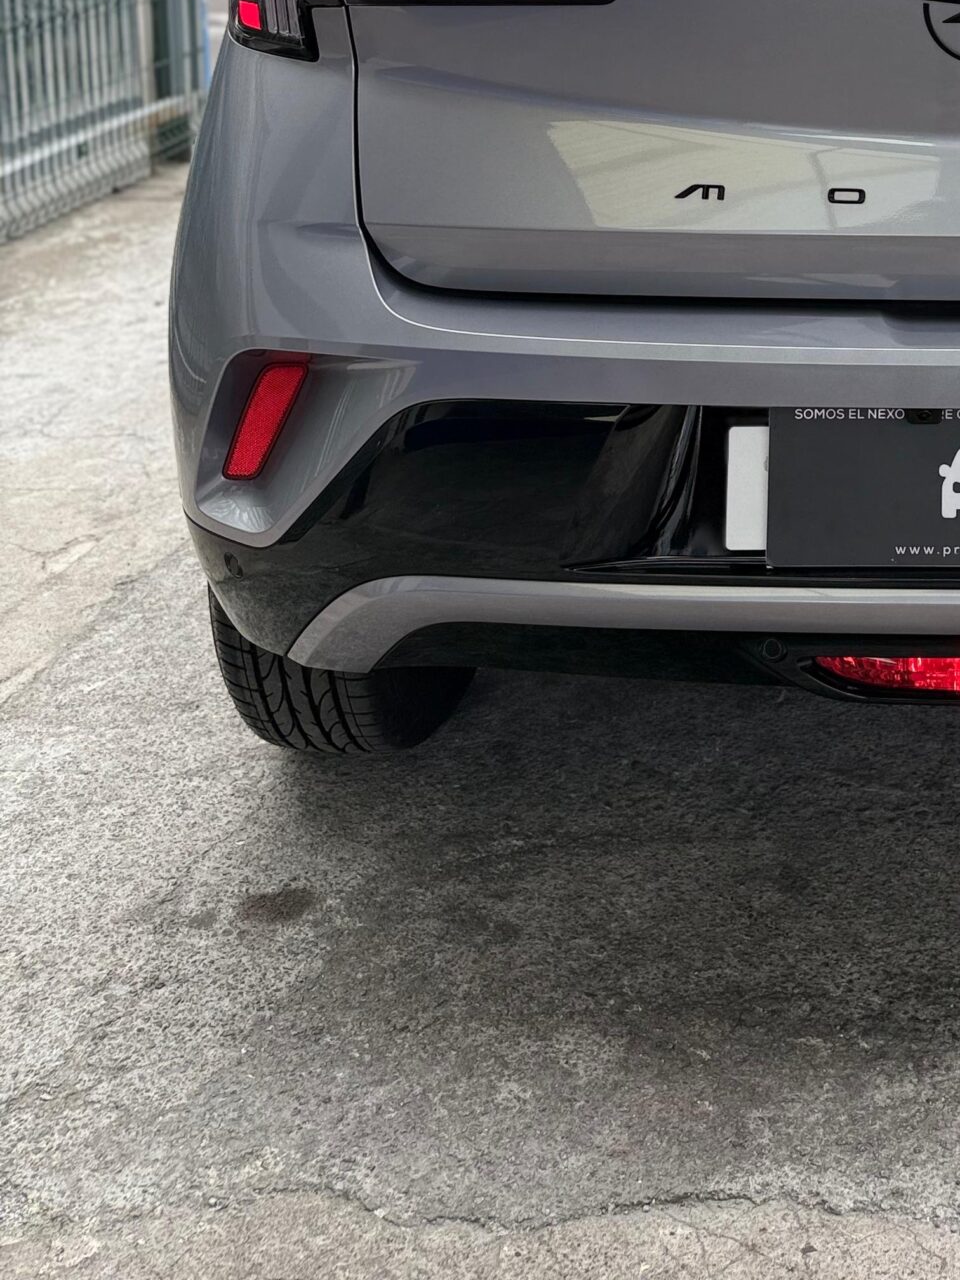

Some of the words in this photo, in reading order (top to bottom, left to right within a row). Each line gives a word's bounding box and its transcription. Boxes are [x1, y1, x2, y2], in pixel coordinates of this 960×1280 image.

[794, 408, 845, 420] SOMOS
[848, 408, 865, 420] EL
[867, 408, 905, 420] NEXO
